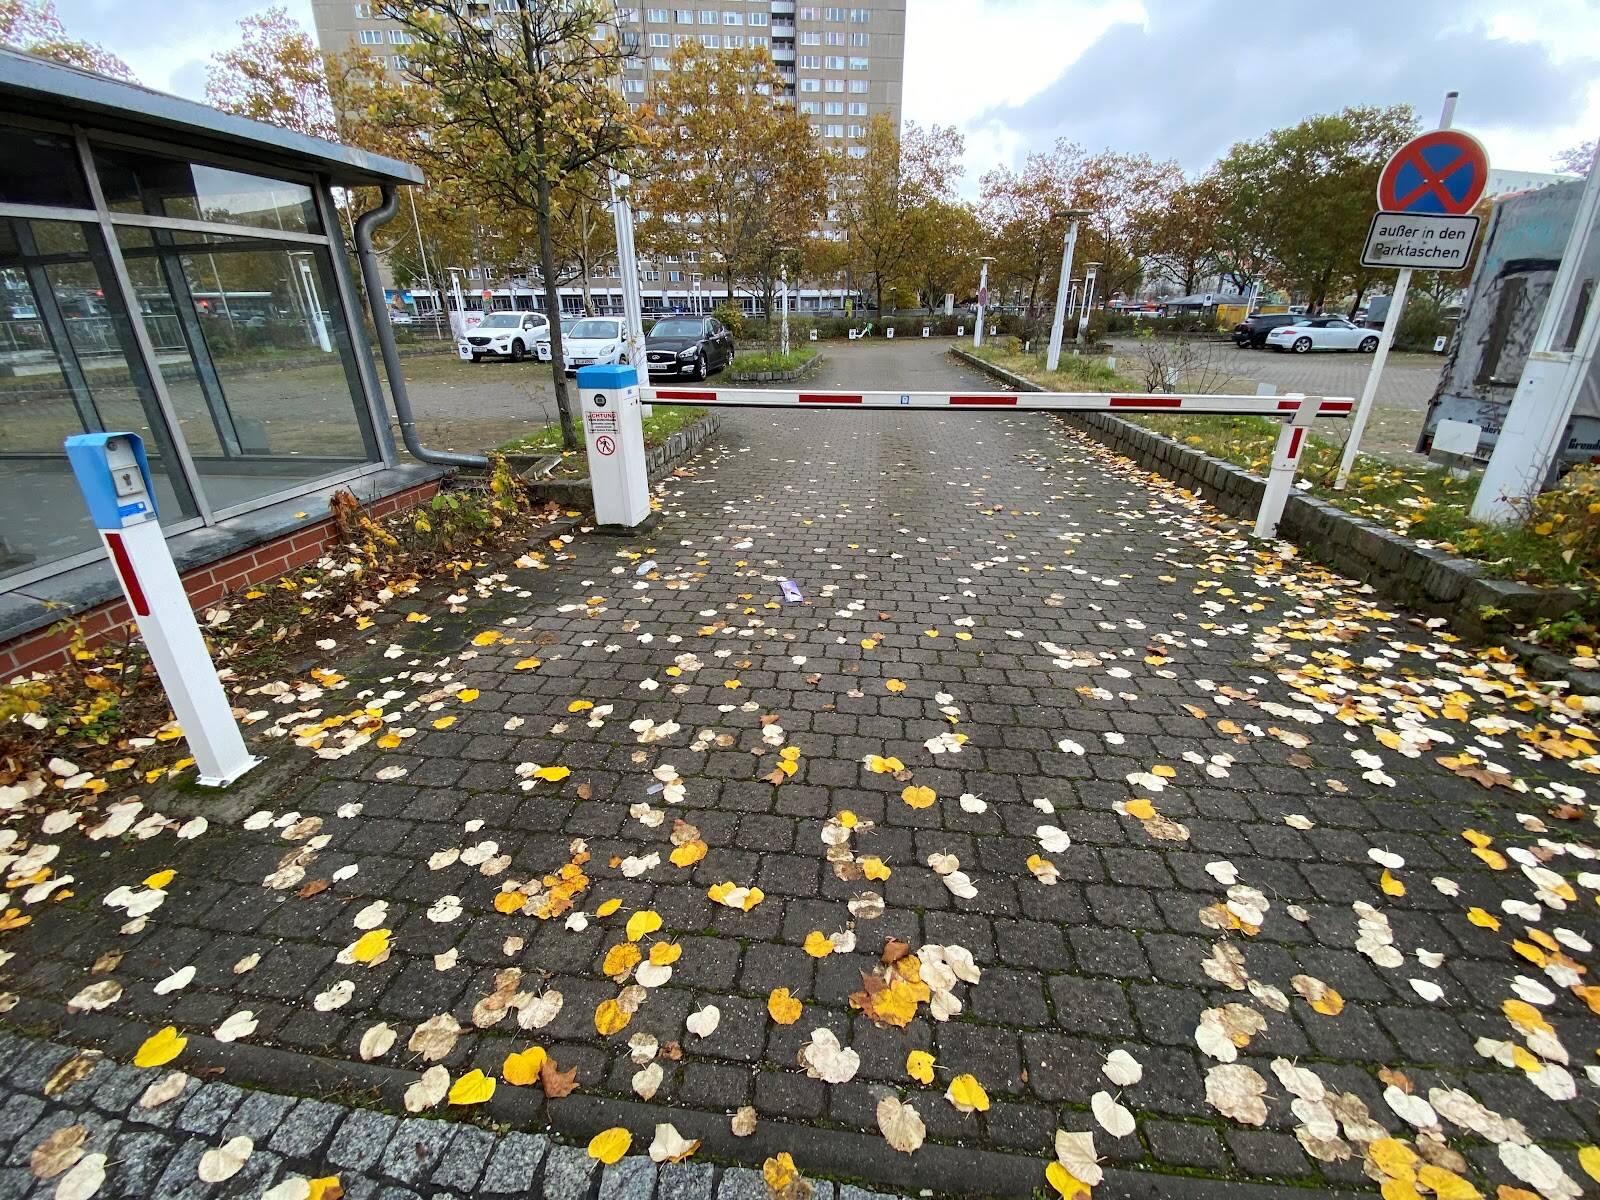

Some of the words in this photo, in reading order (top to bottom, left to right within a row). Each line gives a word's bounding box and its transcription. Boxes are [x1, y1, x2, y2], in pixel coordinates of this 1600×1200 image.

[1379, 225, 1420, 238] außer
[1422, 226, 1434, 239] in
[1439, 227, 1466, 239] den
[1375, 242, 1460, 258] Parktaschen
